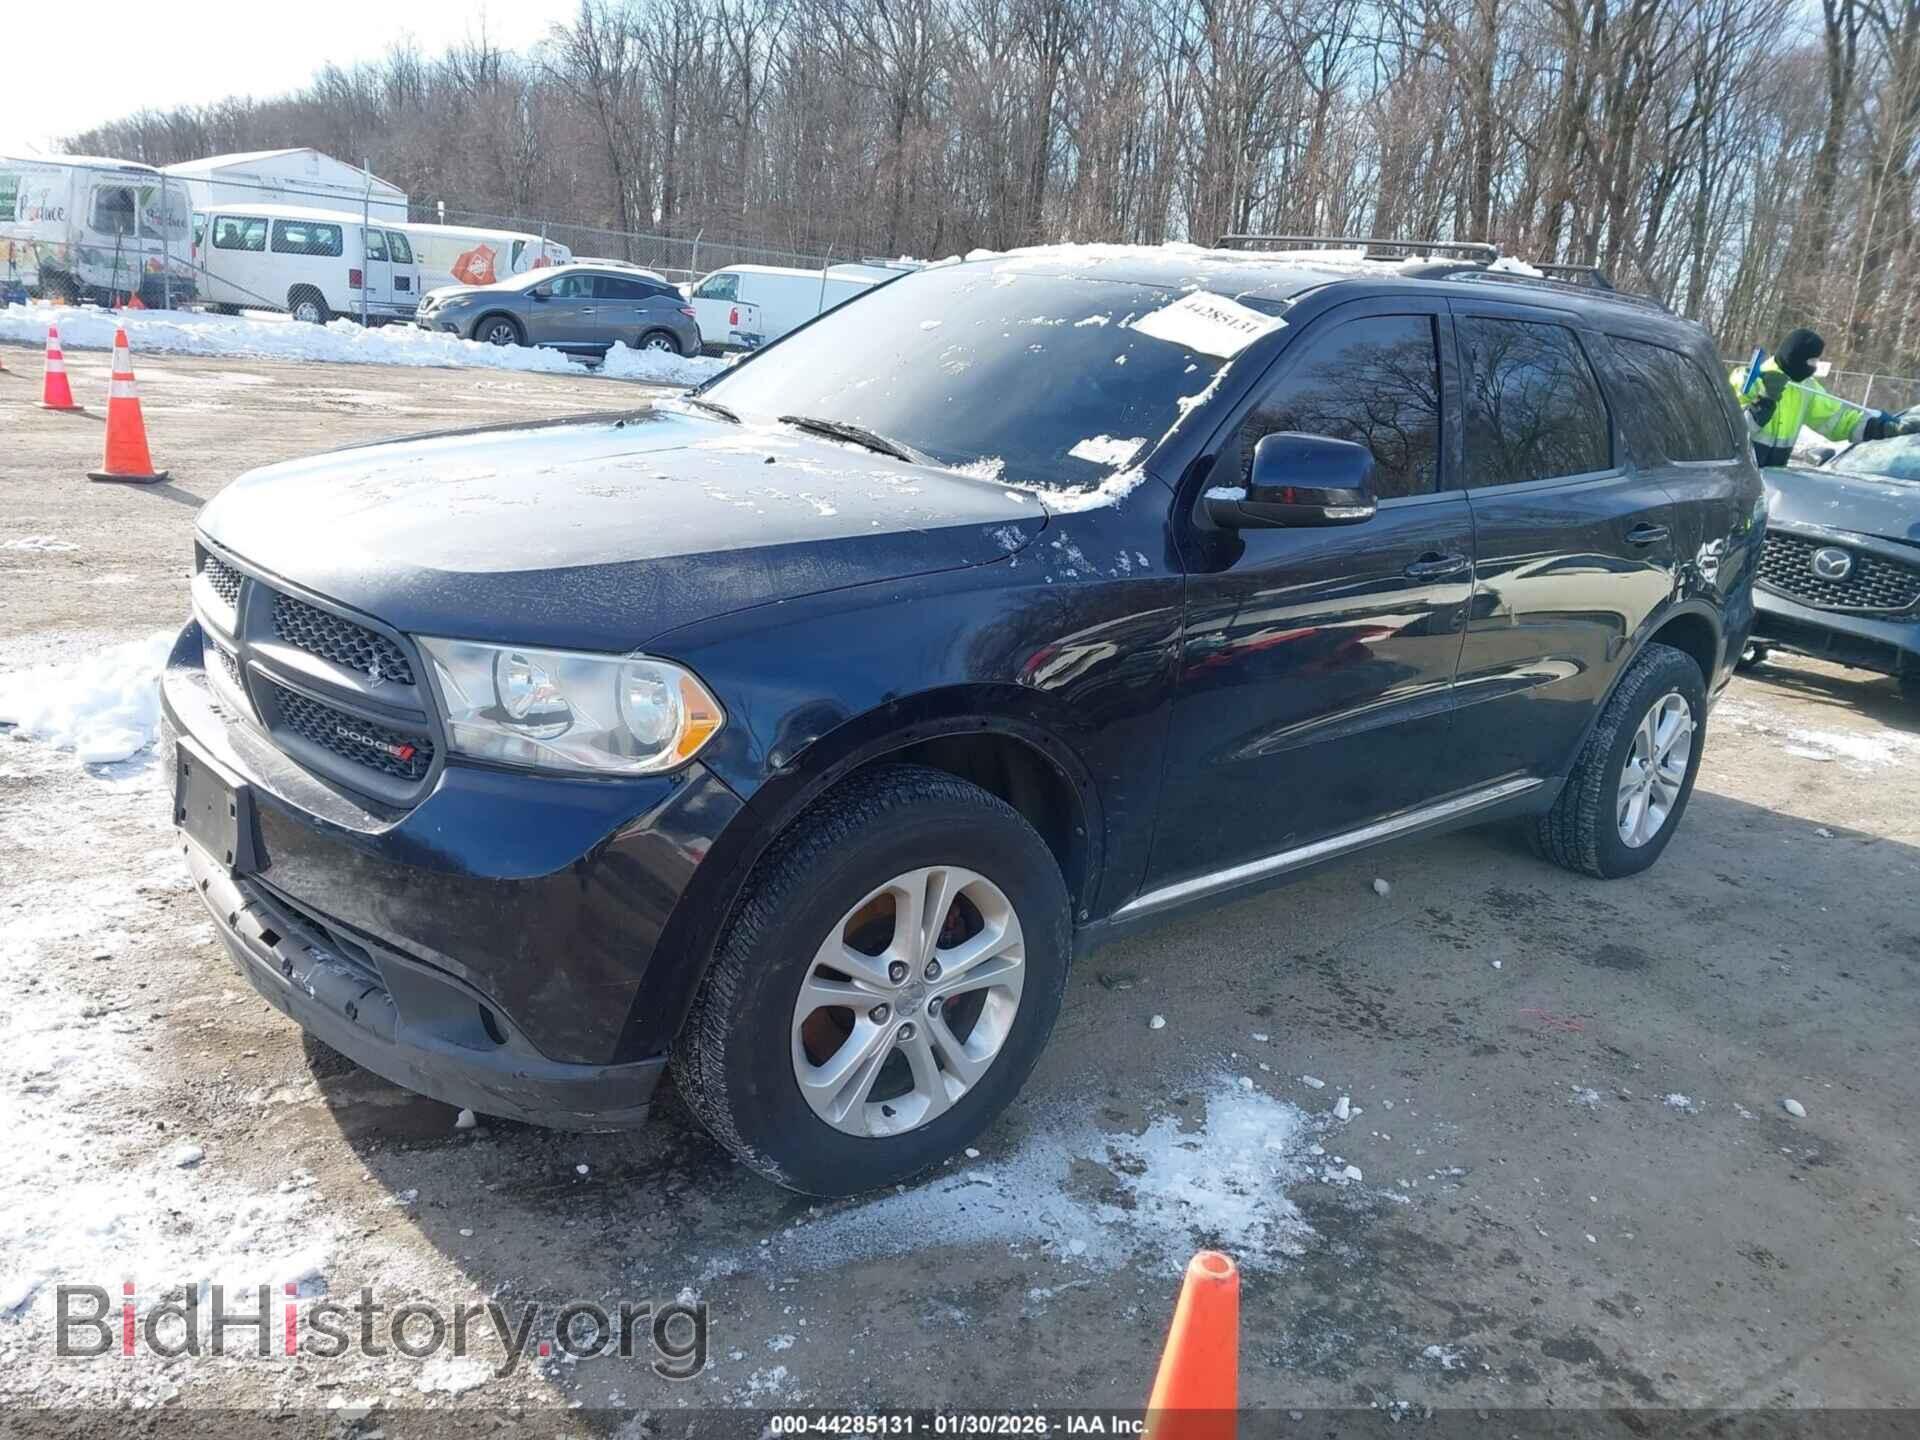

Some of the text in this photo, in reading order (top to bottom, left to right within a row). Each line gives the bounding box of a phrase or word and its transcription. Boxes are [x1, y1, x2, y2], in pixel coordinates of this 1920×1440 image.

[20, 194, 66, 222] Pduce
[1184, 303, 1260, 334] 44285131
[336, 726, 401, 756] DODGE
